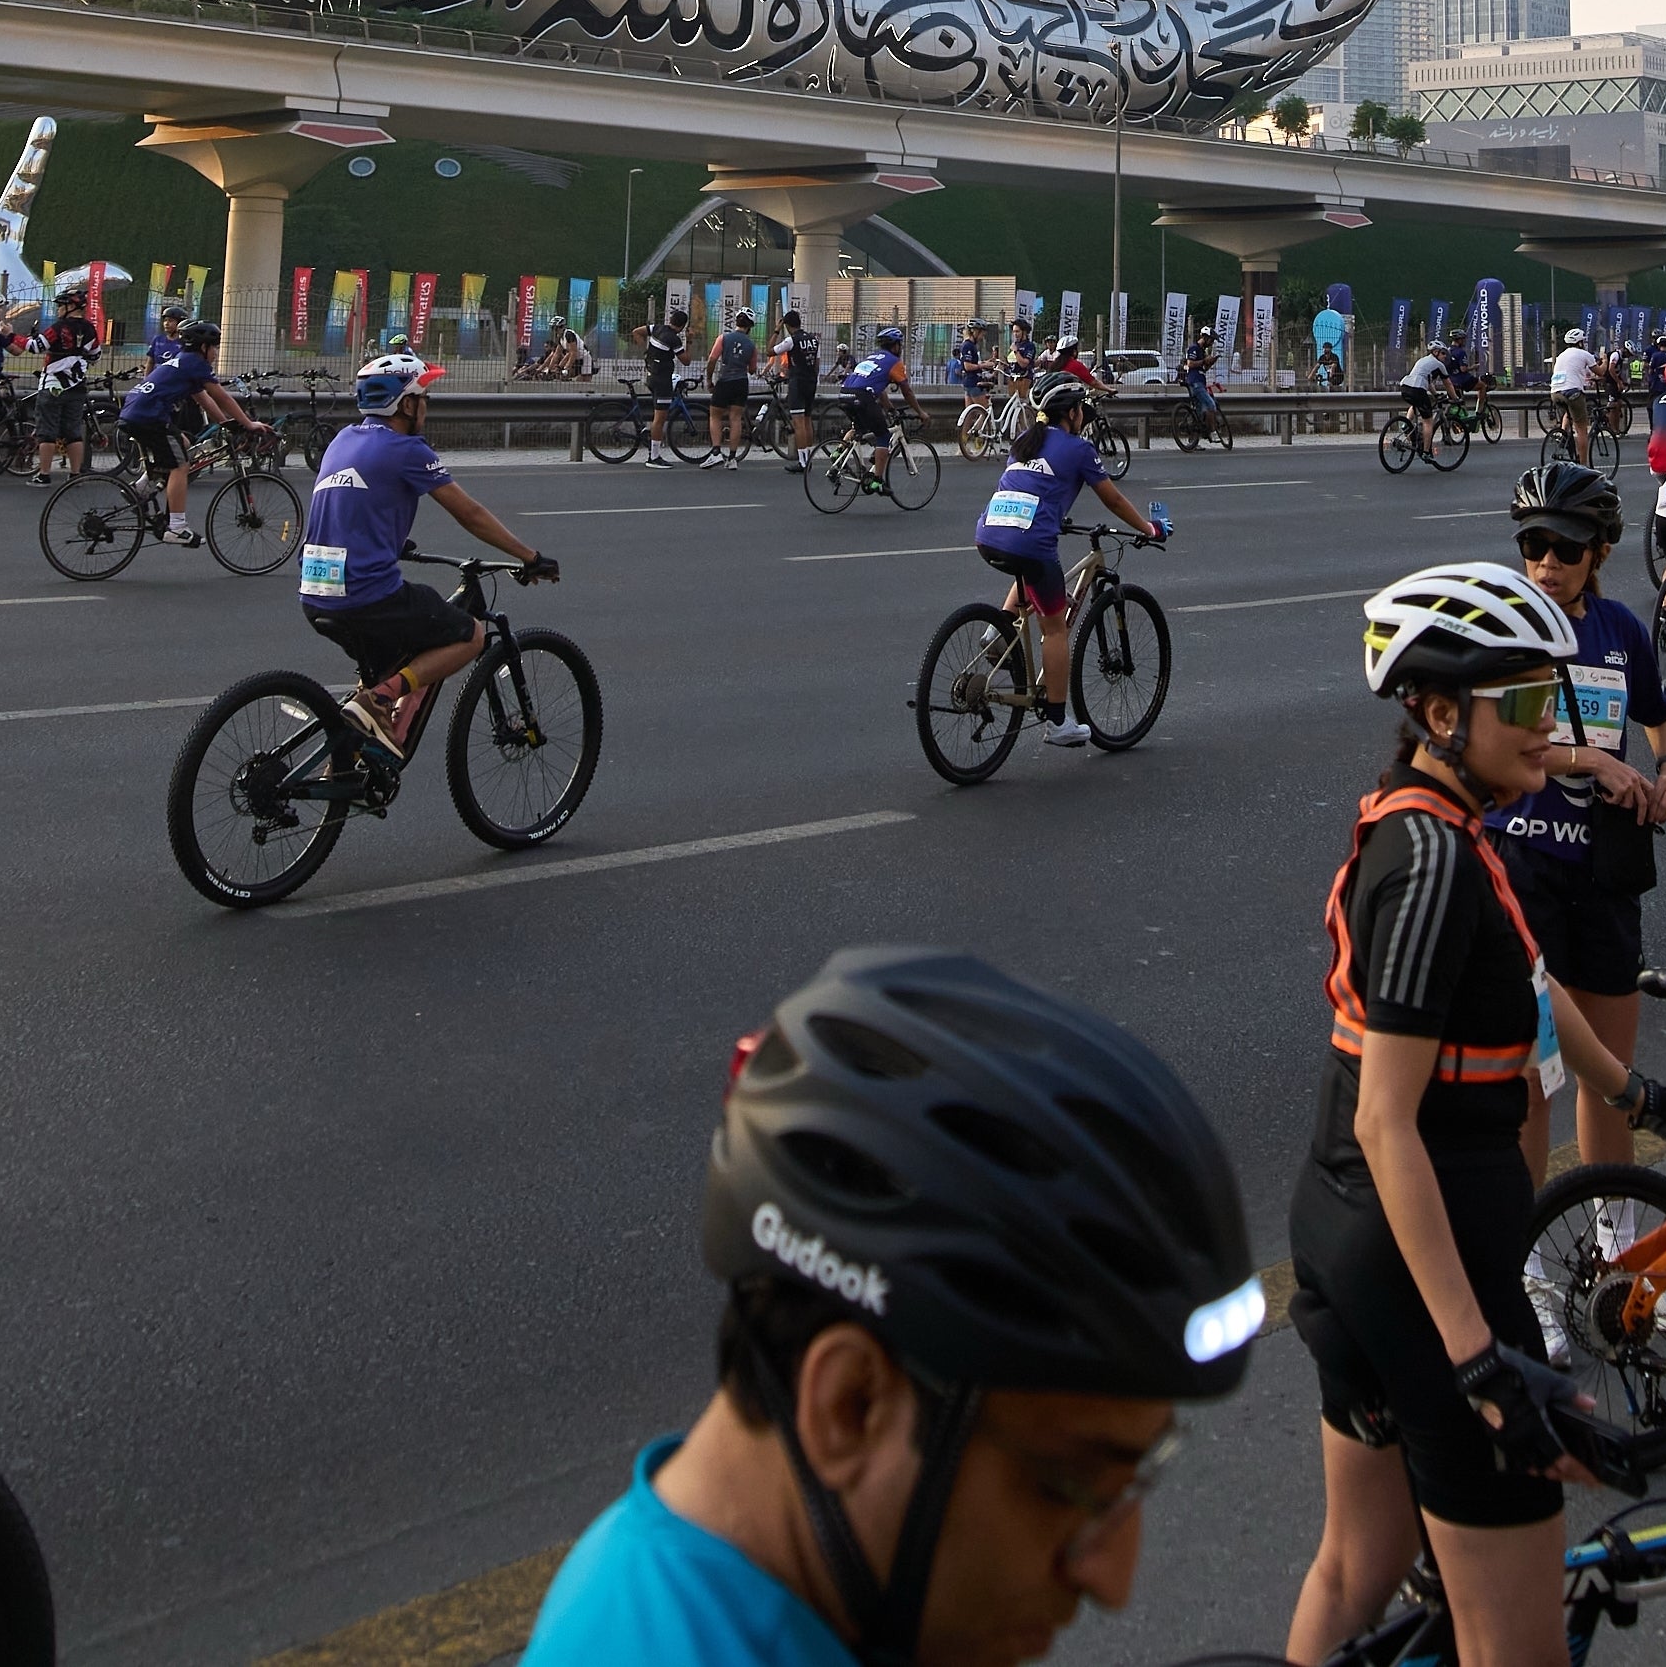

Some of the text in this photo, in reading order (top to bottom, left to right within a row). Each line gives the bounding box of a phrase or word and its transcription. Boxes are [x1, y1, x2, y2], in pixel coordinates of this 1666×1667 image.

[294, 276, 308, 340] Emirates
[413, 281, 431, 345] Emirates
[520, 284, 536, 347] Emirates
[1396, 305, 1405, 339] WORLD
[1435, 306, 1444, 340] WORLD
[1480, 288, 1489, 348] DP WORLD
[1166, 306, 1179, 356] HUAWEI
[1216, 308, 1230, 357] HUAWEI
[1255, 308, 1265, 358] HUAWEI
[1637, 311, 1645, 341] WORLD
[799, 339, 818, 350] UAE
[329, 473, 354, 487] RTA
[1023, 461, 1044, 473] RTA
[994, 505, 1018, 513] 07130
[1433, 617, 1472, 635] PMT
[1604, 655, 1625, 666] RIDE
[1506, 816, 1548, 837] DP
[752, 1201, 890, 1316] Gudook
